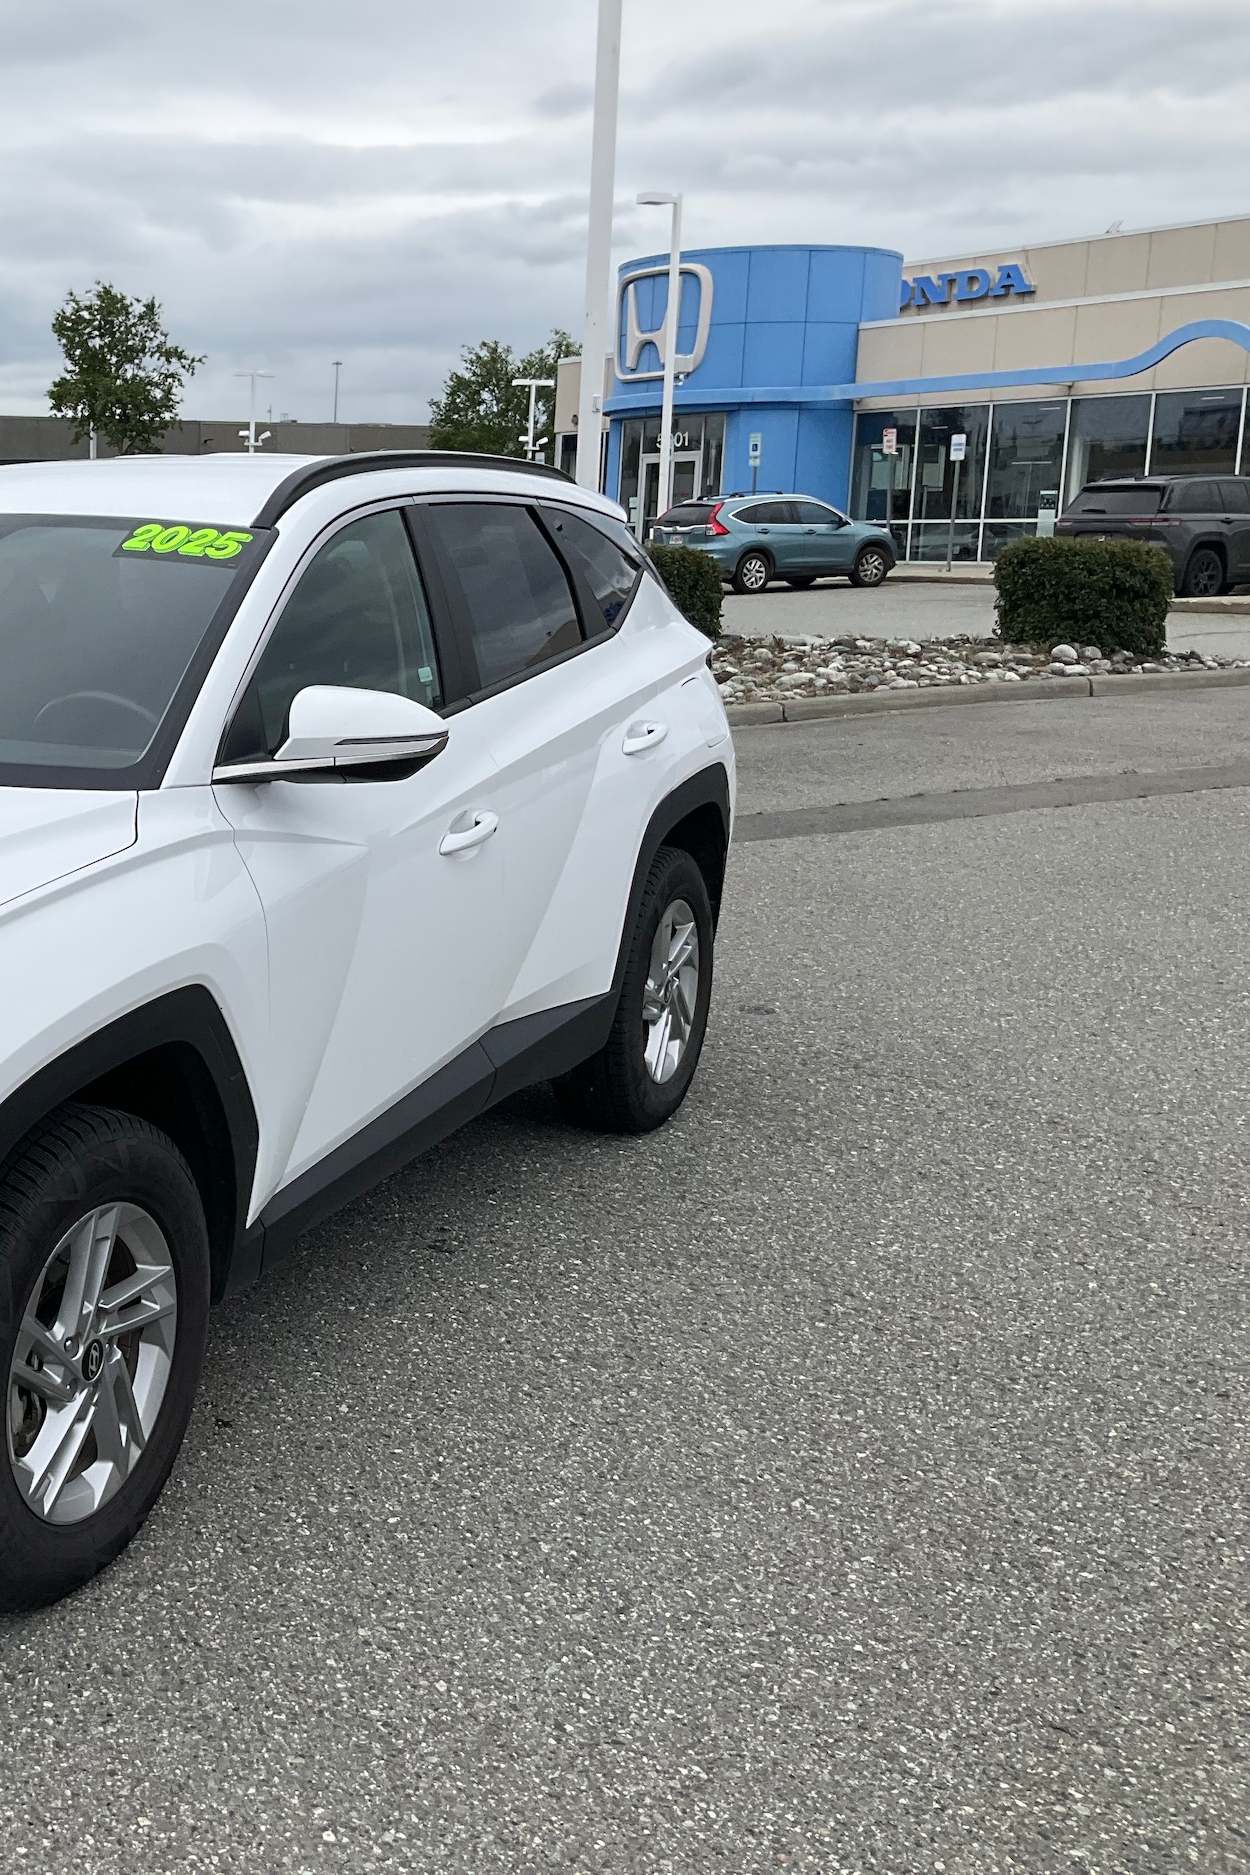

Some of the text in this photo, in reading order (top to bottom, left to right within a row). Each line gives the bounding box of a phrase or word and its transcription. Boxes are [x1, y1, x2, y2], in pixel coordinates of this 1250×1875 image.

[901, 263, 1036, 308] NDA
[656, 431, 689, 448] 501
[122, 523, 253, 560] 2025
